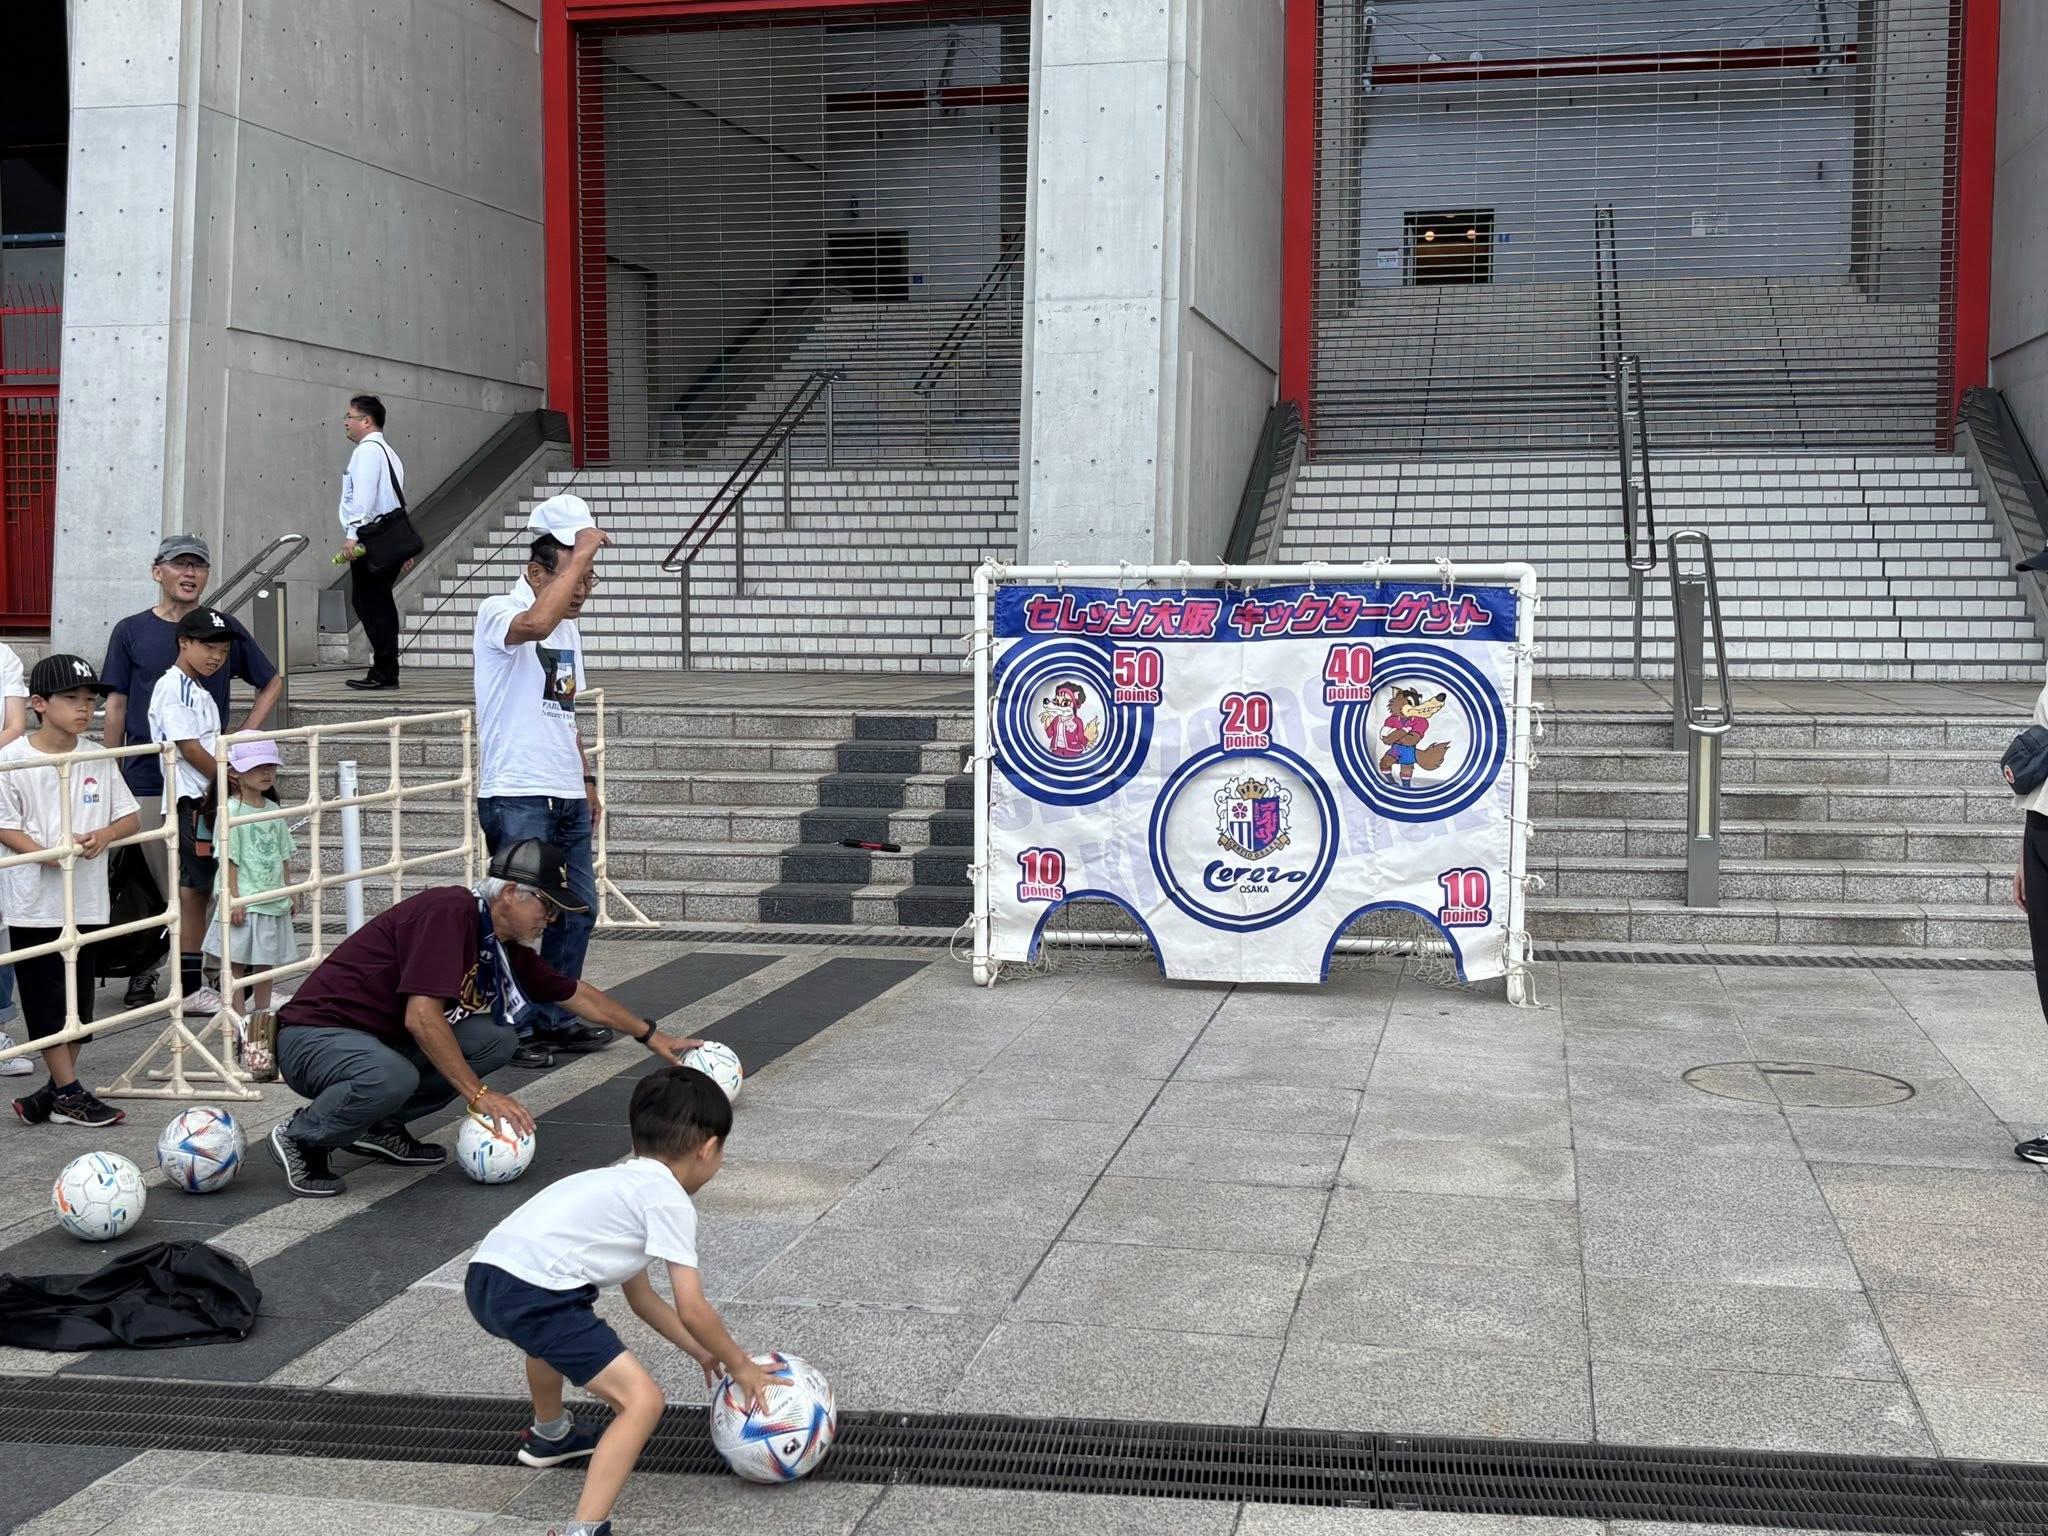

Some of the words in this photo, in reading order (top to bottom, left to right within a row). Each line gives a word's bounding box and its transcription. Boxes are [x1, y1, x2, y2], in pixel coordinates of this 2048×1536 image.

[210, 612, 225, 627] LA
[1026, 594, 1219, 638] セレッソ大阪
[1230, 592, 1491, 636] キックターゲット
[73, 661, 92, 677] NY
[1115, 651, 1159, 688] 50
[1327, 647, 1371, 684] 40
[1116, 689, 1158, 702] points
[1327, 686, 1370, 700] points
[1224, 696, 1268, 733] 20
[1225, 734, 1268, 749] points
[1022, 851, 1061, 885] 10
[1203, 860, 1307, 892] Cerezo
[1021, 885, 1062, 899] points
[1239, 885, 1269, 893] OSAKA
[1443, 871, 1485, 908] 10
[1442, 910, 1487, 924] points
